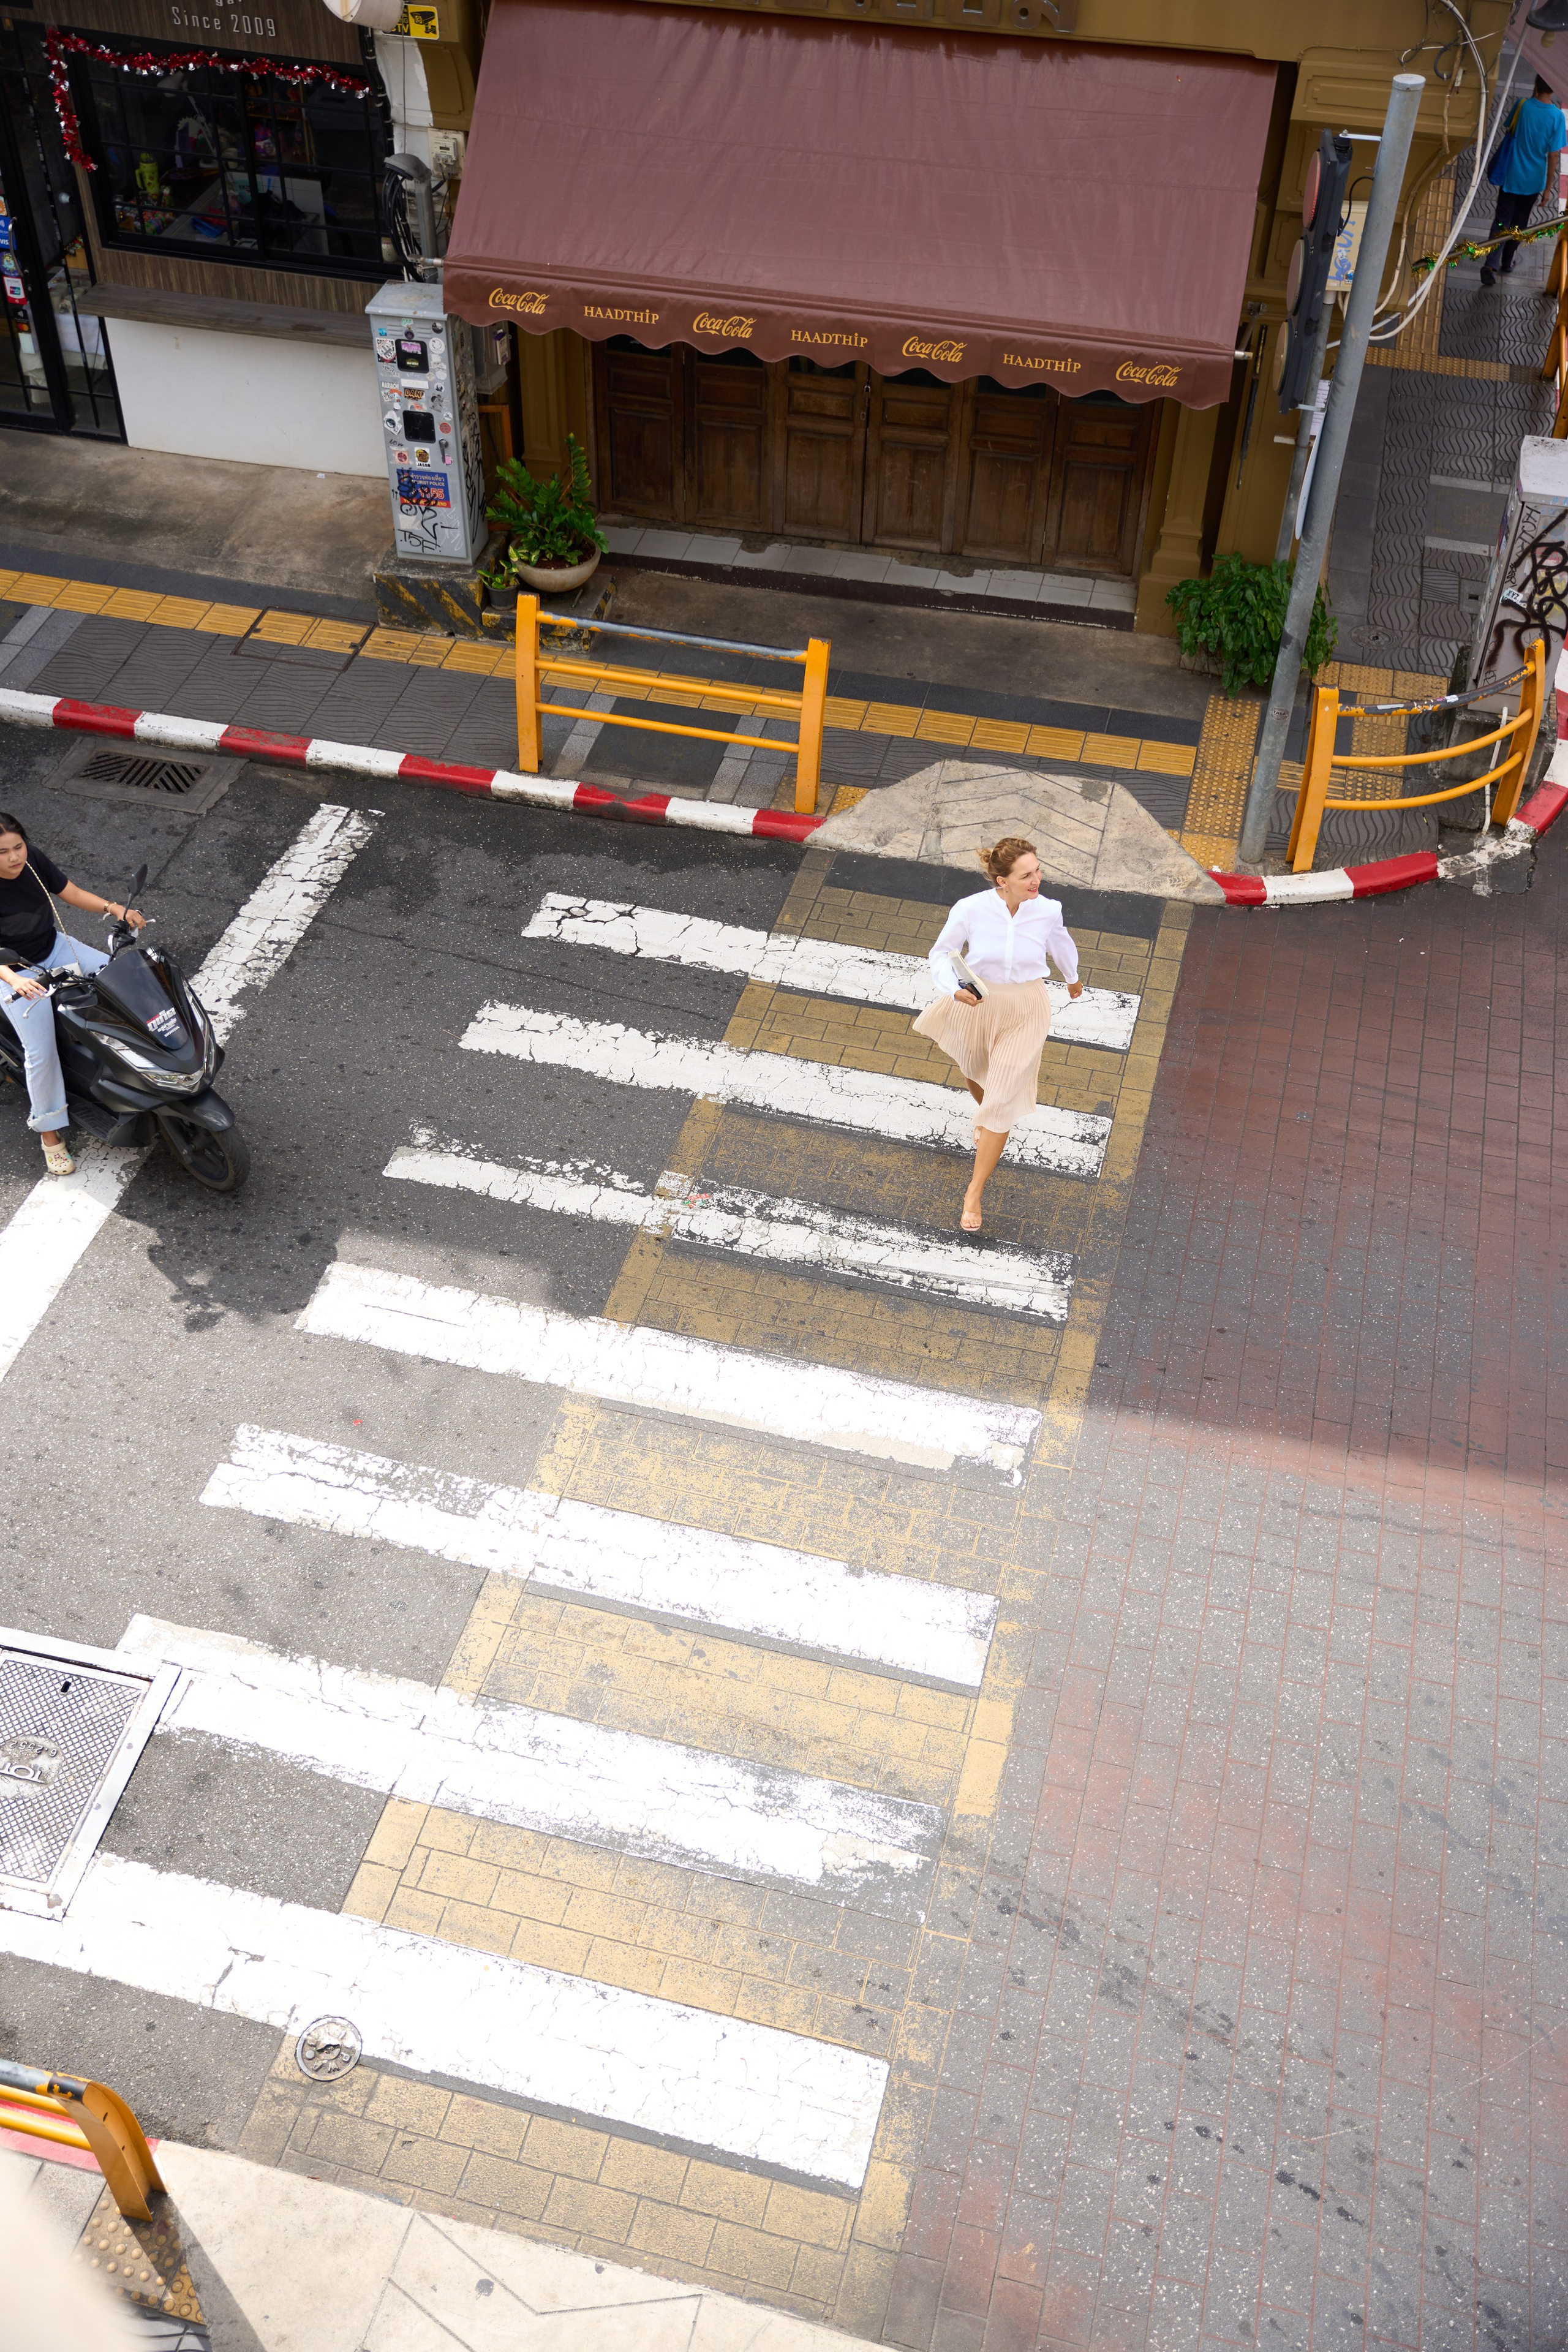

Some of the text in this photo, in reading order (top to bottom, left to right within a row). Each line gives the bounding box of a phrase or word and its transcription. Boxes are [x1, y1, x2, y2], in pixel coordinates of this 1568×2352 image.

[172, 7, 276, 37] Since 2009
[489, 288, 549, 314] Coca-Cola
[692, 312, 757, 338] Coca-Cola
[902, 336, 968, 363] Coca-Cola
[1116, 361, 1183, 387] Coca-Cola
[418, 488, 445, 499] 1155
[164, 1026, 180, 1038] HONDA
[9, 1740, 58, 1758] 6.2552
